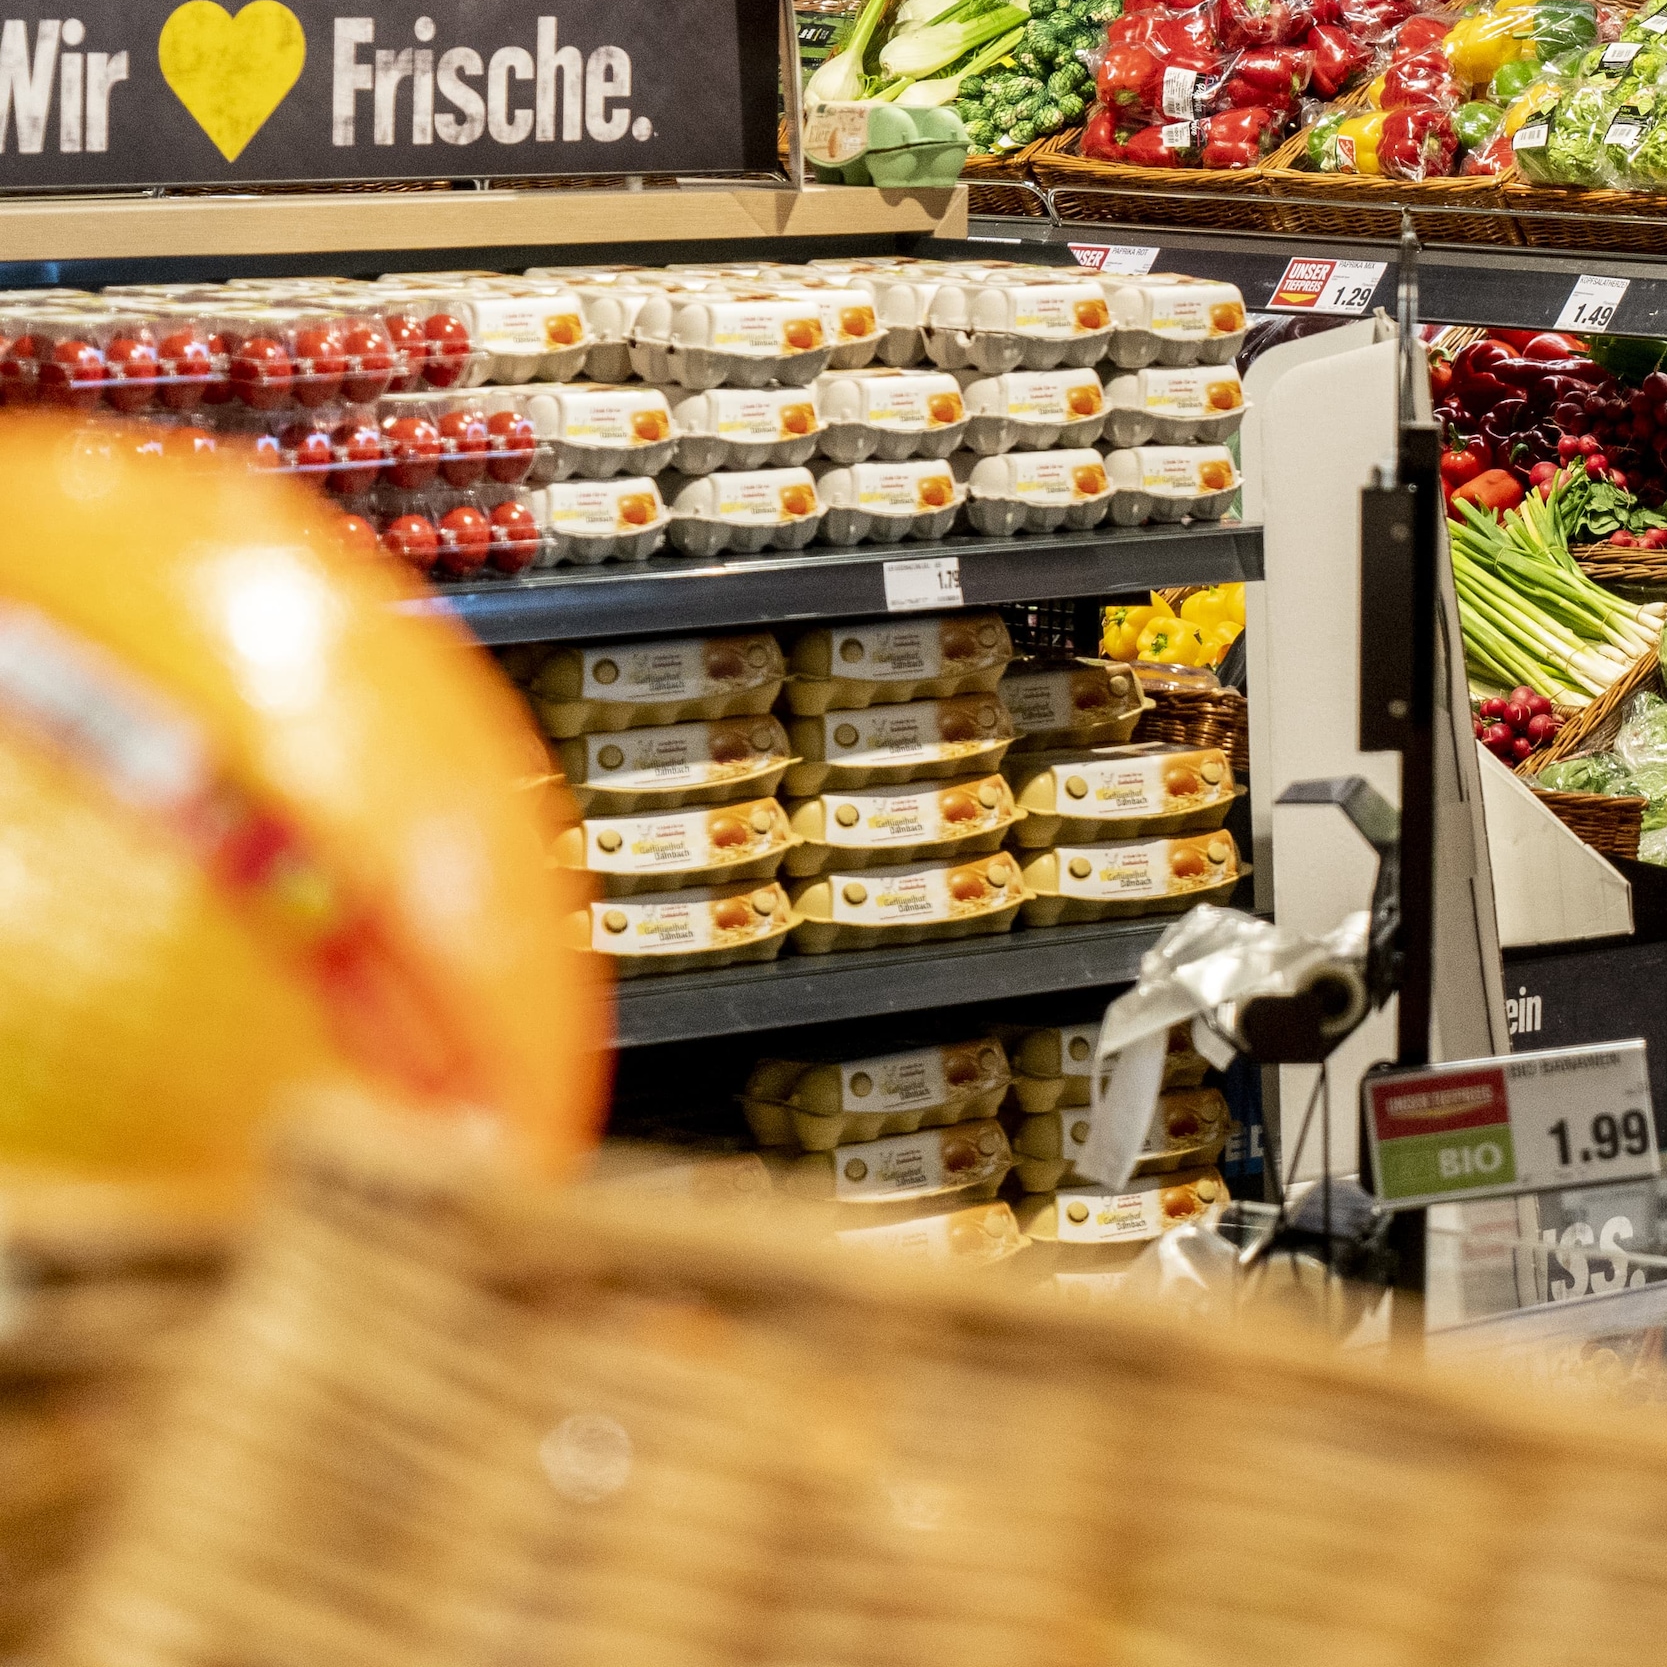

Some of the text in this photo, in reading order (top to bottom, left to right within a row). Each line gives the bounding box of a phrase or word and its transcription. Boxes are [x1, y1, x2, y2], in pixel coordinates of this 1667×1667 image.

[332, 15, 656, 147] Frische.
[1111, 248, 1149, 257] PAPRIKA ROT
[1289, 262, 1330, 282] UNSER
[1339, 260, 1376, 270] PAPRIKA MIX
[1283, 279, 1324, 294] TIEFPREIS
[1333, 287, 1372, 308] 1.29
[1573, 303, 1613, 327] 1.49
[1549, 1108, 1650, 1166] 1.99
[1438, 1140, 1503, 1179] BIO
